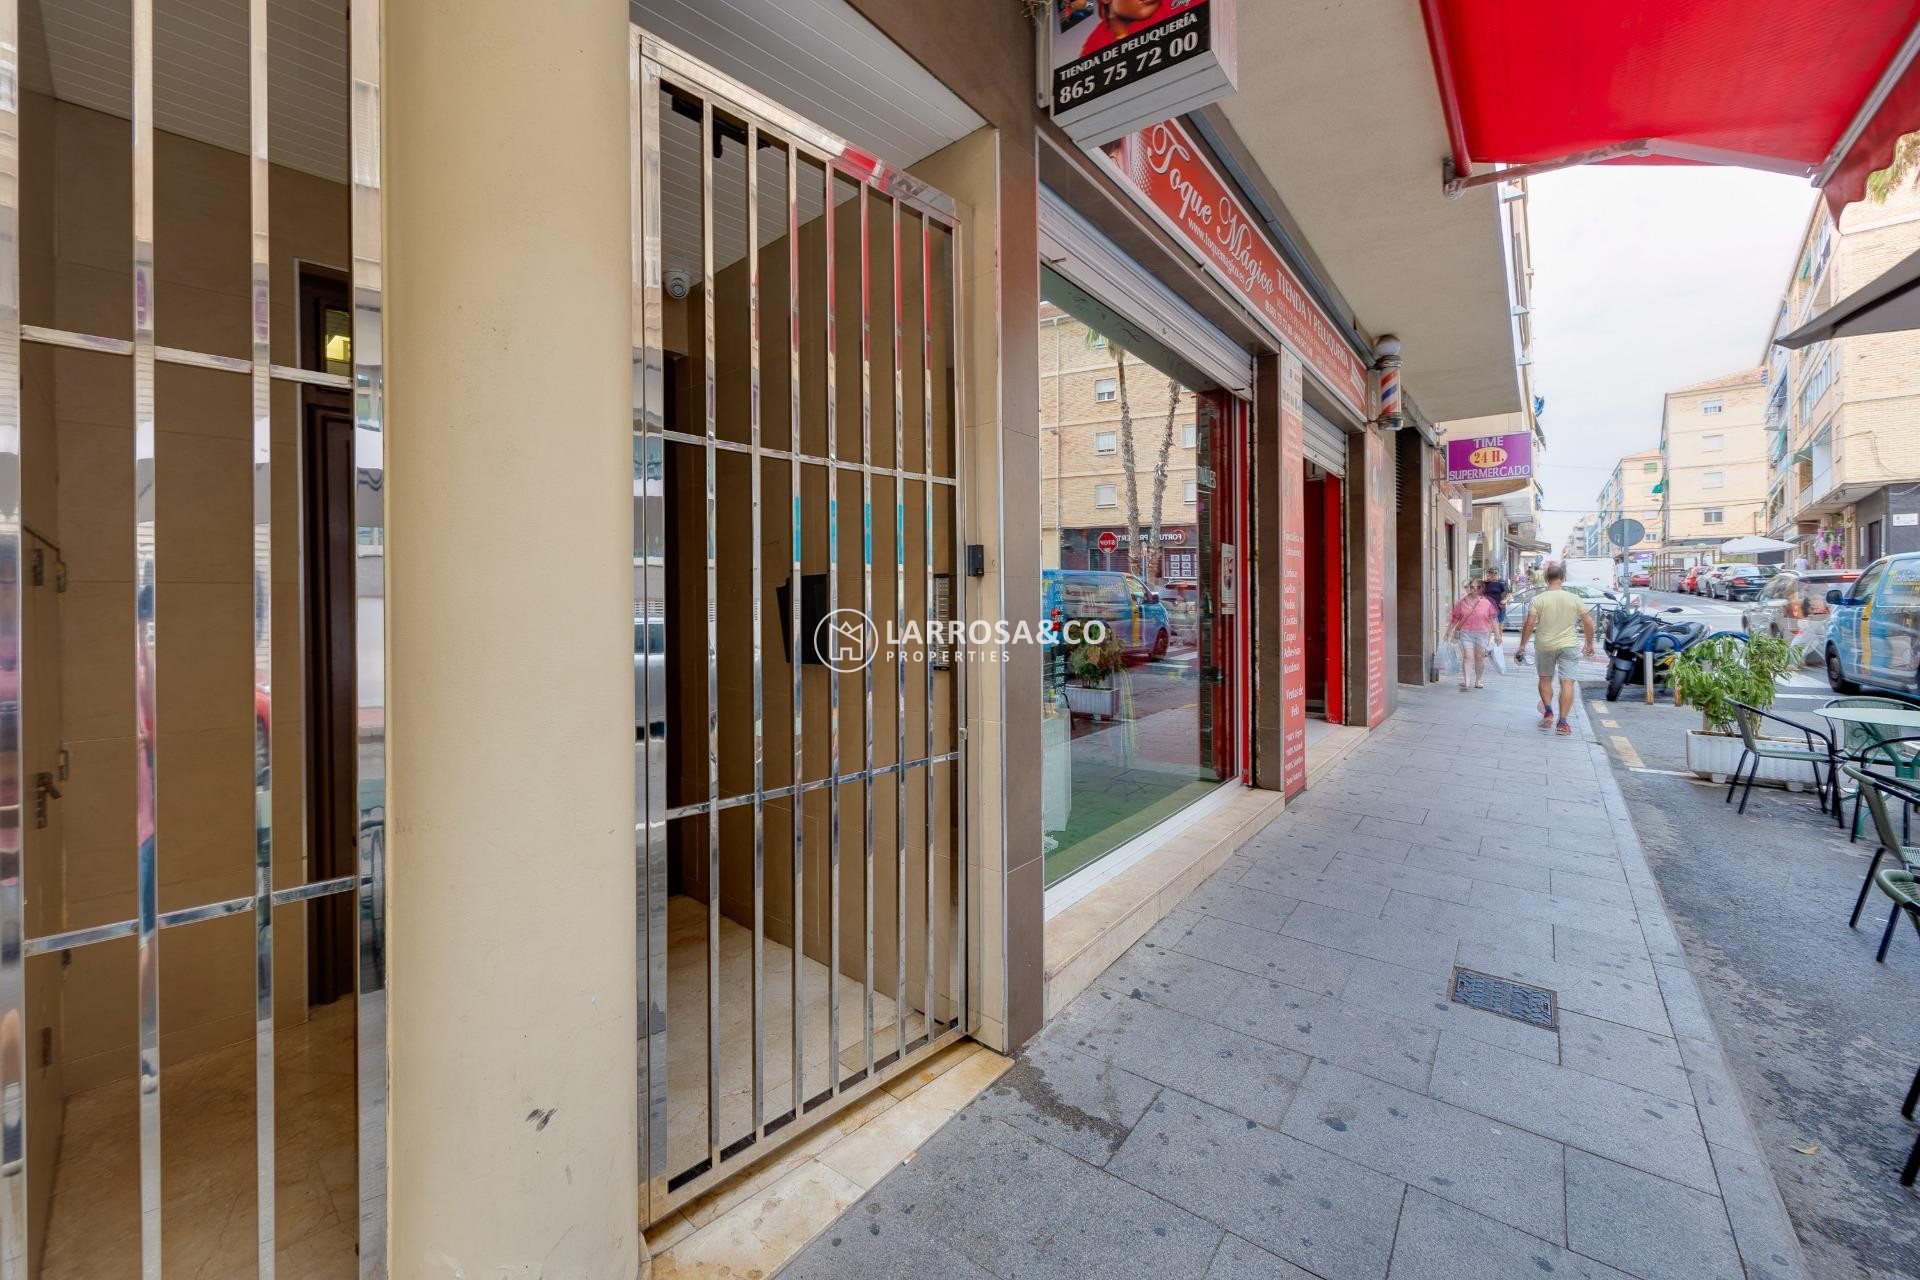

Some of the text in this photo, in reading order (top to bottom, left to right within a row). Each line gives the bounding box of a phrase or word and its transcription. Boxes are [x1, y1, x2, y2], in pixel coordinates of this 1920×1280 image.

[1060, 12, 1198, 81] TIENDA DE PELUQUERÍA
[1060, 31, 1199, 104] 865 75 72 00
[1147, 122, 1212, 225] Toque
[1277, 269, 1307, 320] TIENDA
[1307, 306, 1313, 326] Y
[1473, 436, 1504, 448] TIME
[1474, 450, 1488, 464] 24
[1449, 464, 1530, 481] SUPERMERCADO
